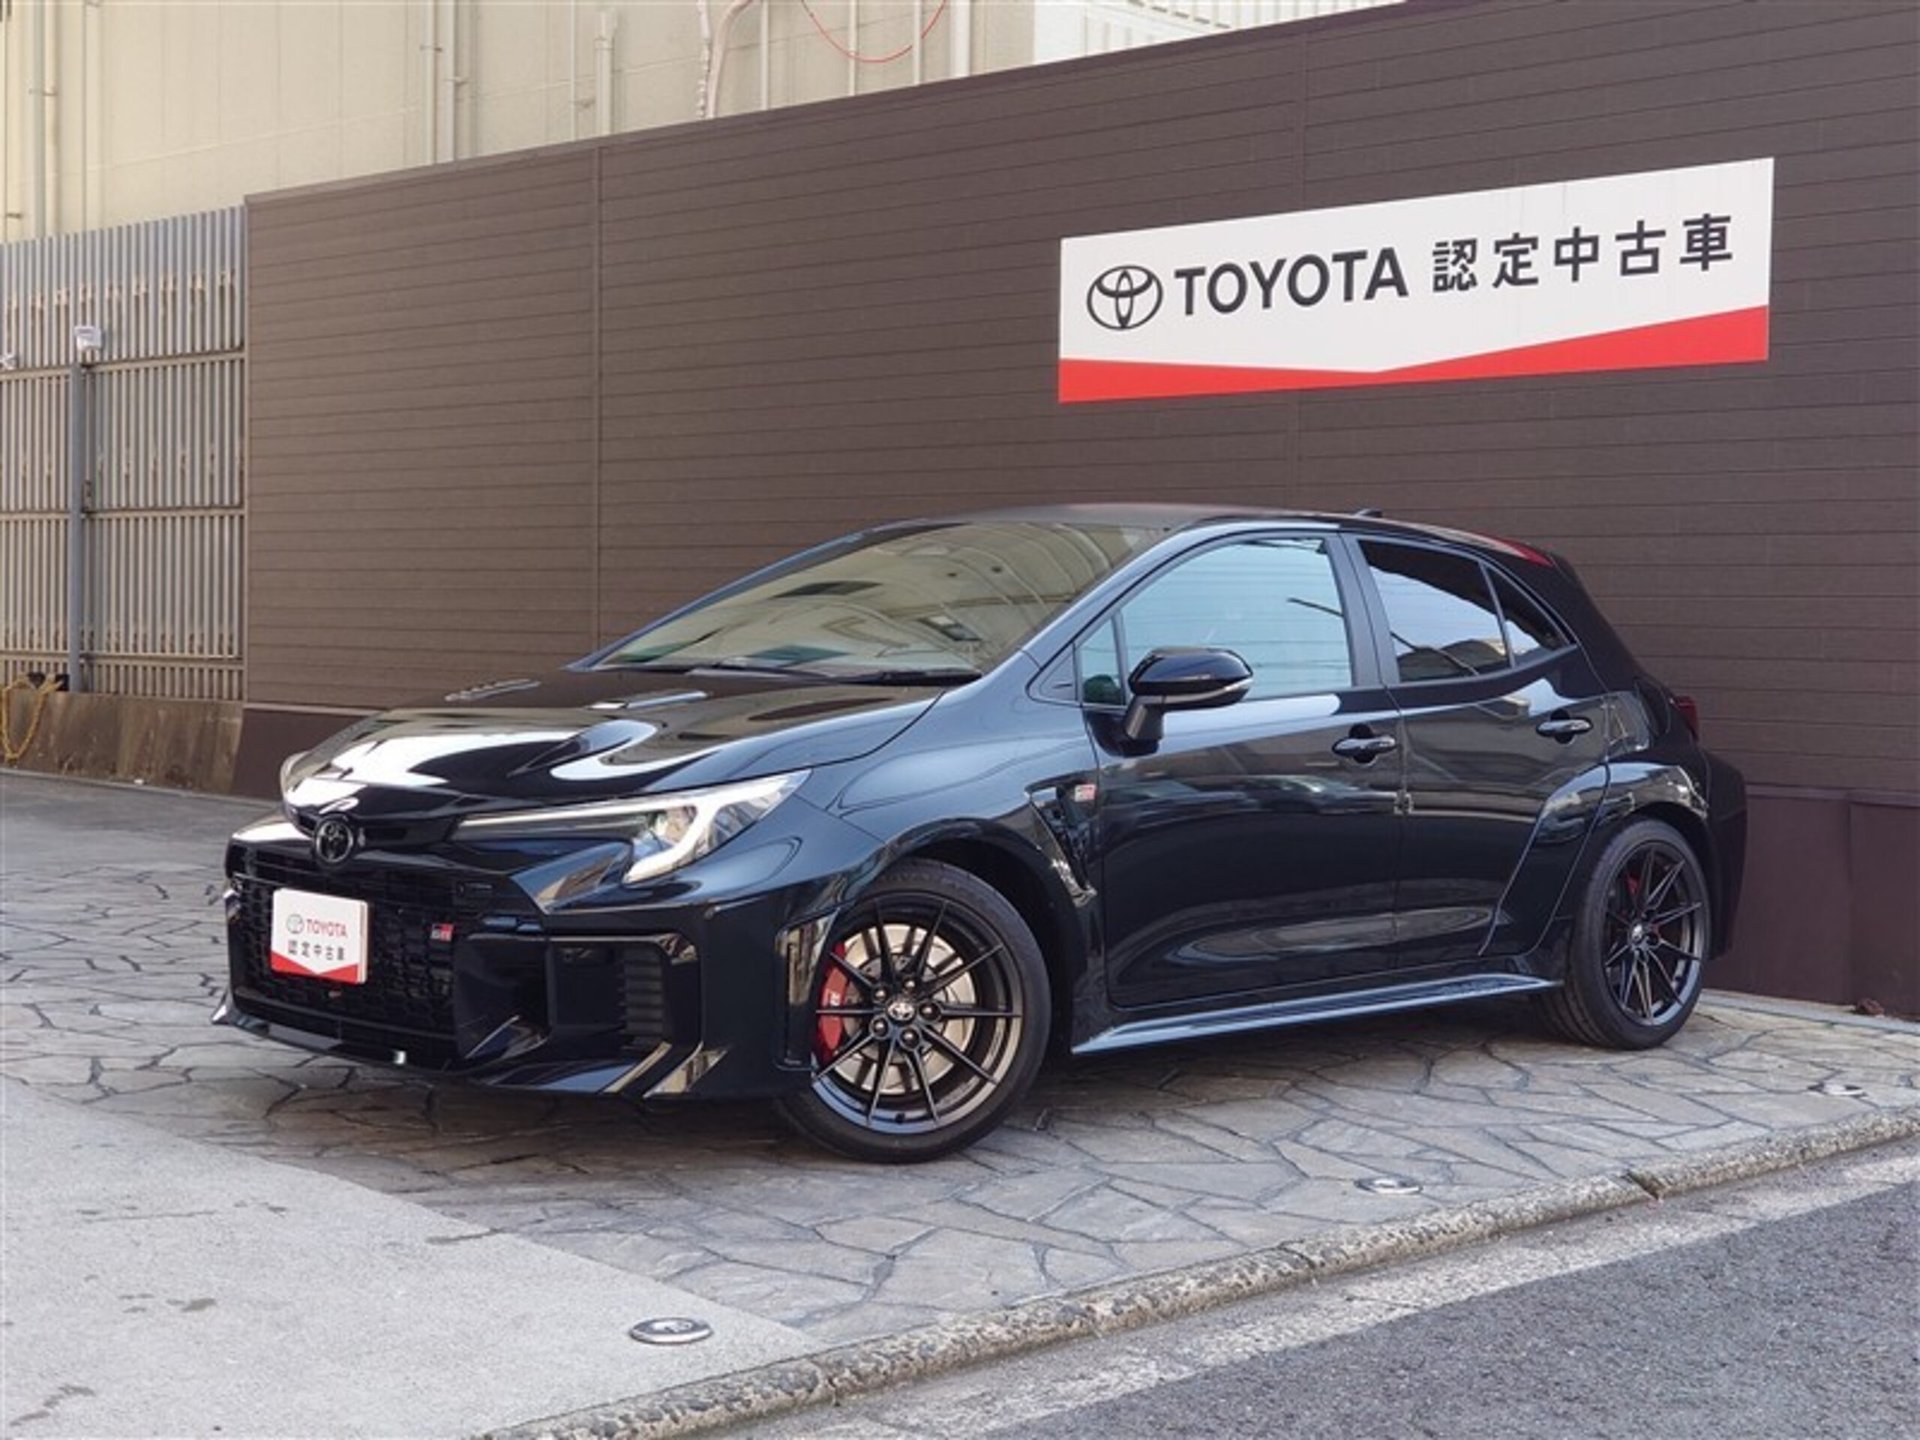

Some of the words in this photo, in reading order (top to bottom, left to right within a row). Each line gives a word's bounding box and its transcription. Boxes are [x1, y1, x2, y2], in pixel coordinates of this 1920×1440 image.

[1175, 248, 1408, 315] TOYOTA
[1433, 214, 1732, 292] 認定中古車
[306, 918, 347, 938] TOYOTA
